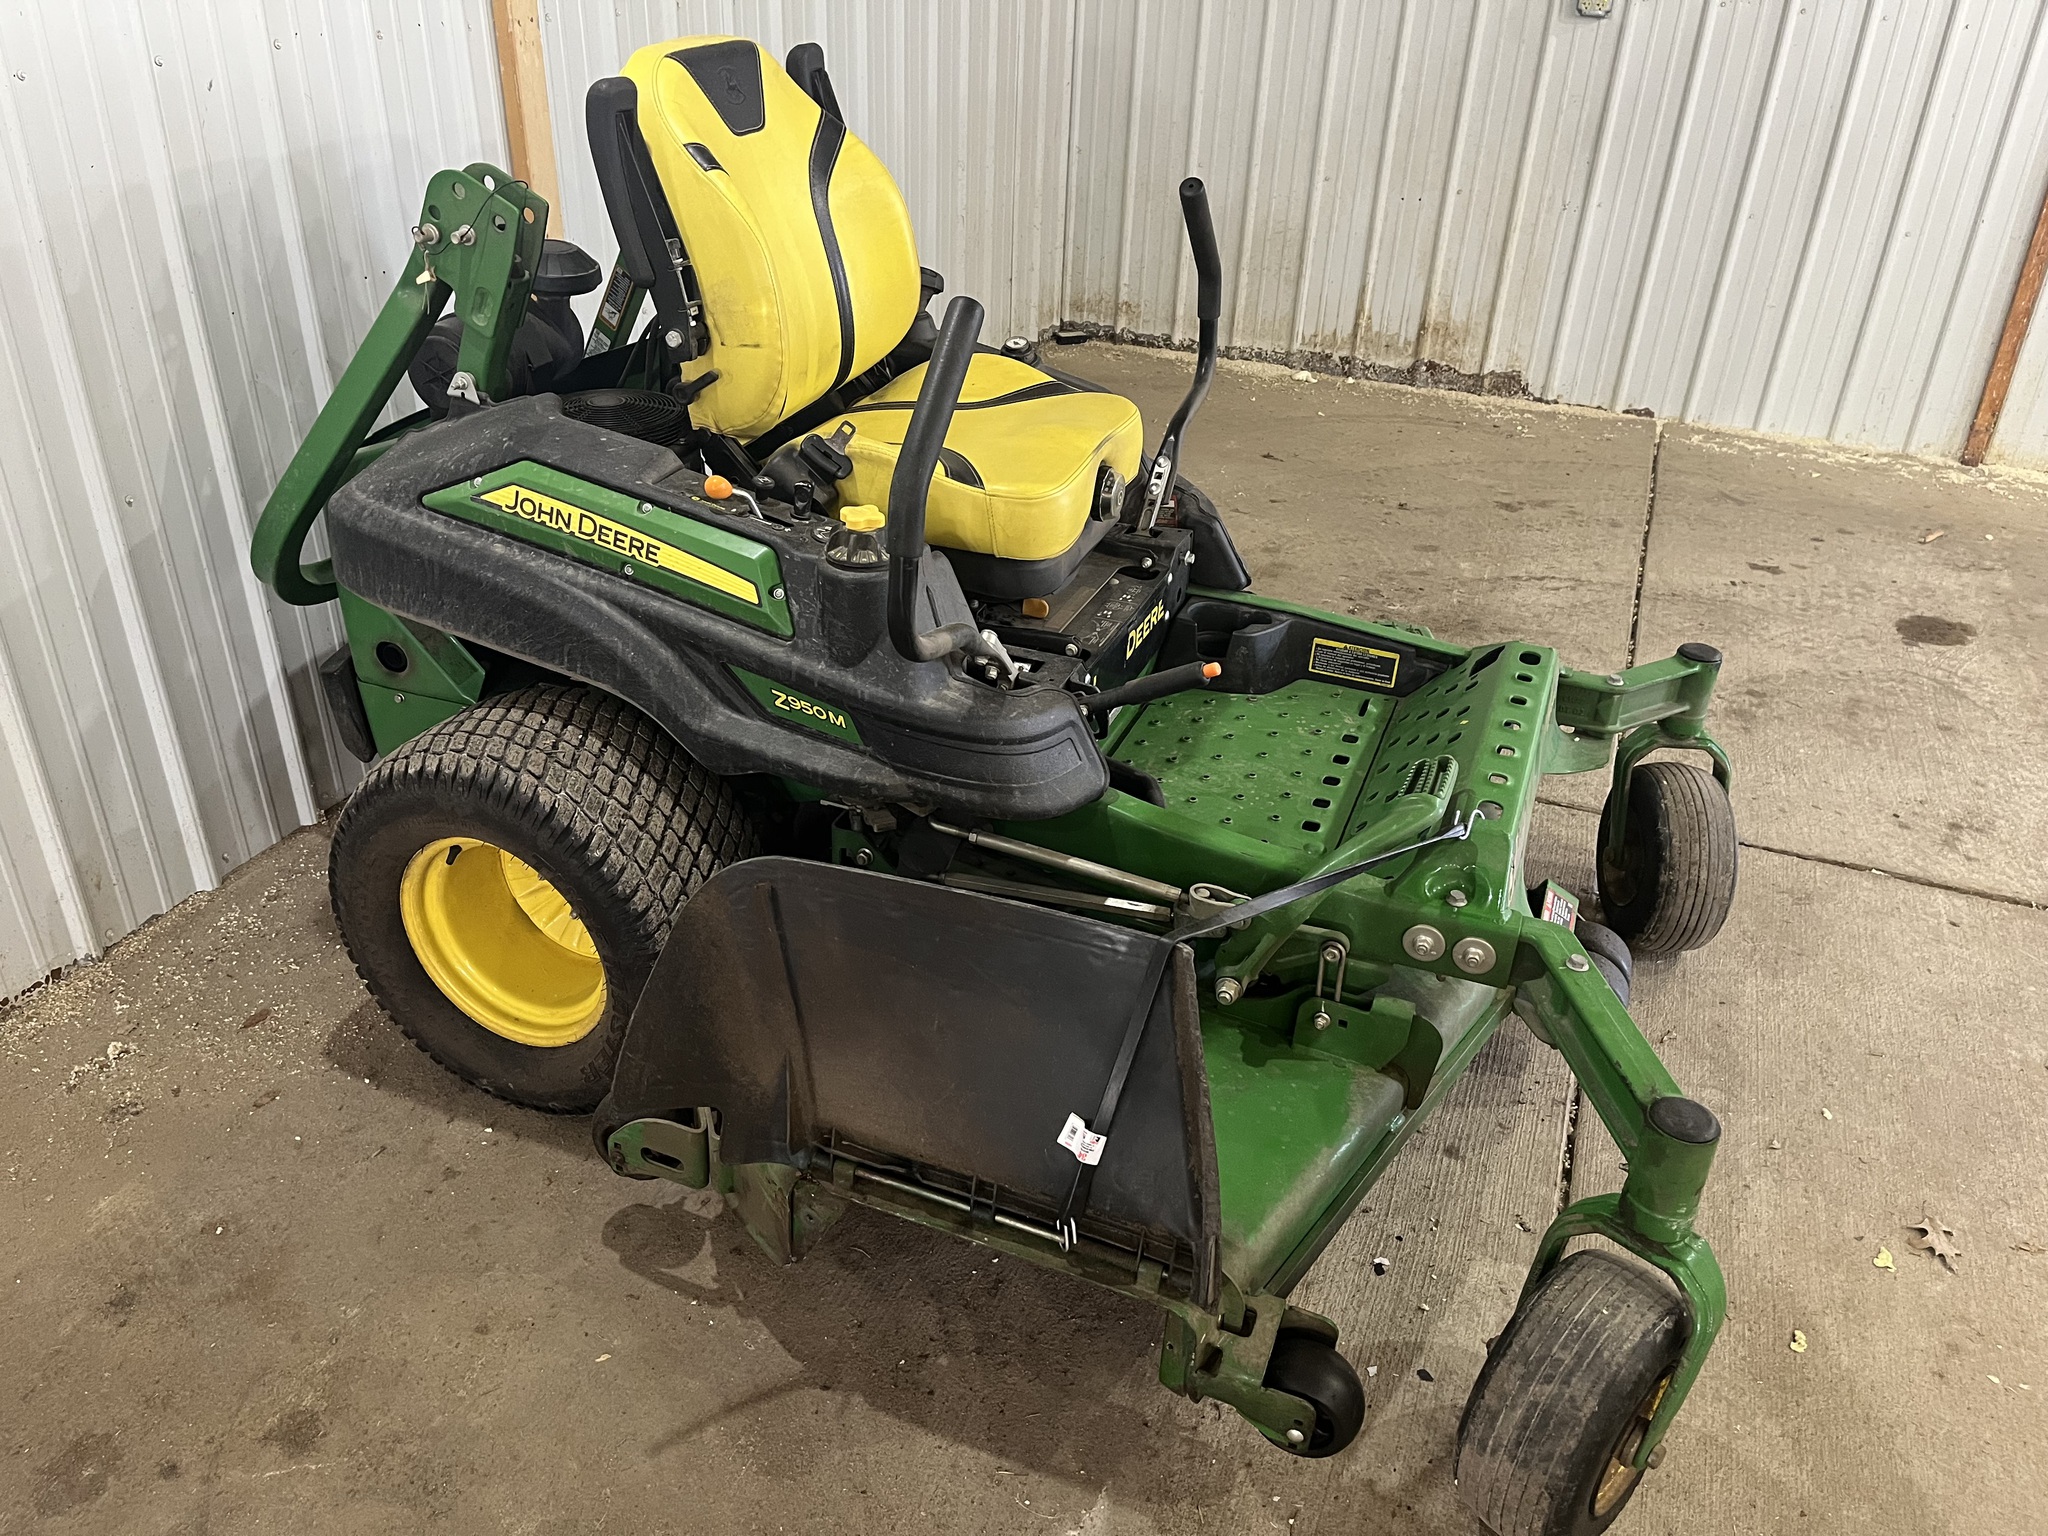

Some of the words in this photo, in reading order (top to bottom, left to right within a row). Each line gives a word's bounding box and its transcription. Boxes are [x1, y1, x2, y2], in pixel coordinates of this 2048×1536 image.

[504, 490, 573, 531] JOHN
[577, 513, 661, 564] DEERE
[1125, 599, 1166, 661] DEERE
[770, 688, 846, 729] Z950M
